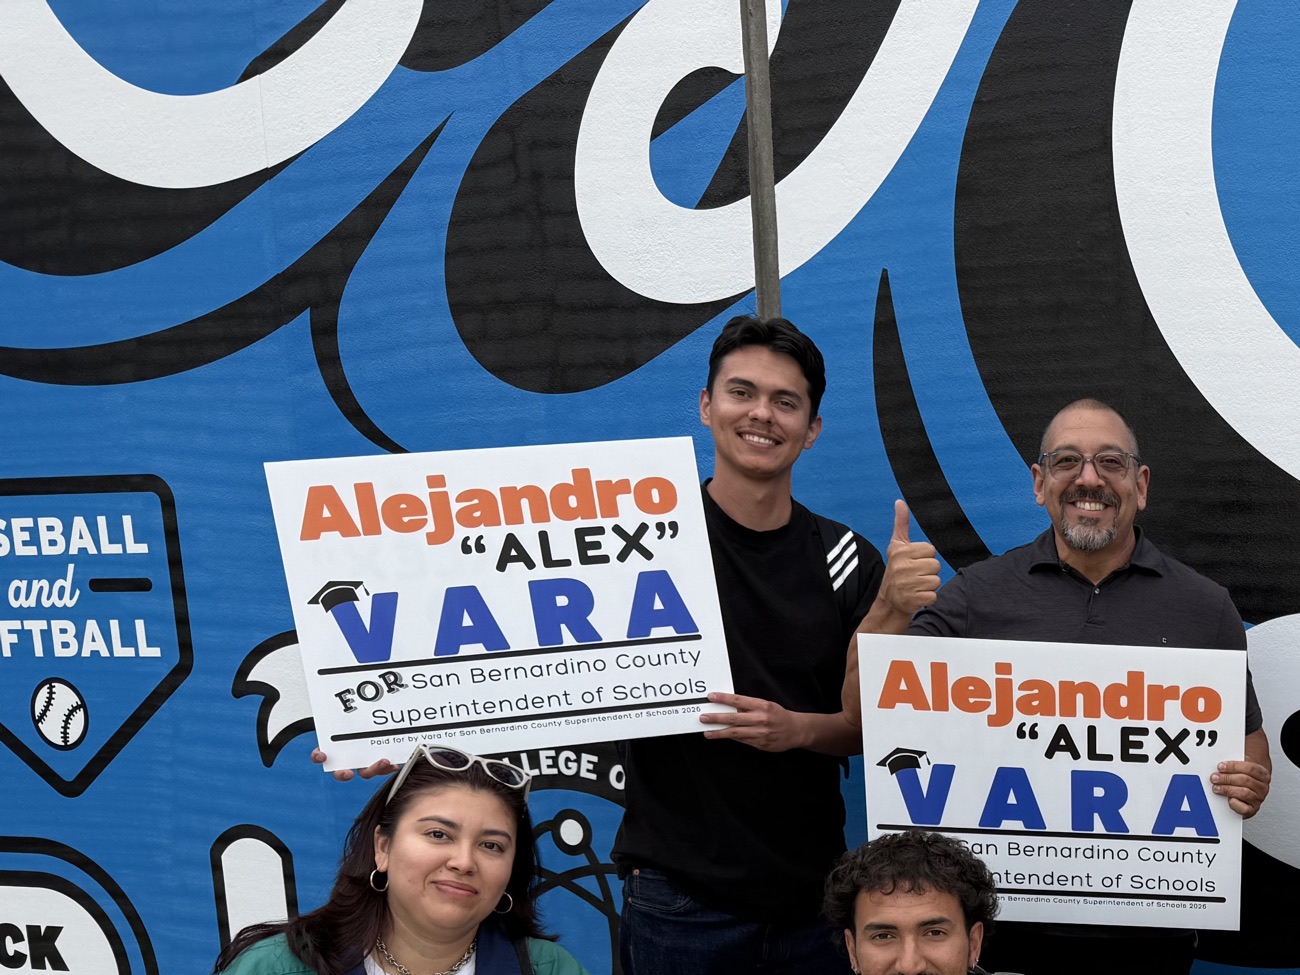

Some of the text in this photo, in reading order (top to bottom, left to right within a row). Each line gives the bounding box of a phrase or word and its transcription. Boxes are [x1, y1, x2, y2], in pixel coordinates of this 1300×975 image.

[299, 468, 678, 546] Alejandro
[461, 520, 679, 573] “ALEX”
[8, 563, 81, 609] and
[329, 569, 699, 664] VARA
[334, 648, 701, 713] FOR San Bernardino County
[372, 678, 706, 726] Superintendent of Schools
[877, 661, 1222, 727] Alejandro
[1016, 722, 1218, 765] “ALEX”
[895, 764, 1219, 837] VARA
[990, 869, 1215, 893] ntendent of Schools
[1008, 841, 1129, 861] Bernardino
[1138, 847, 1217, 868] County
